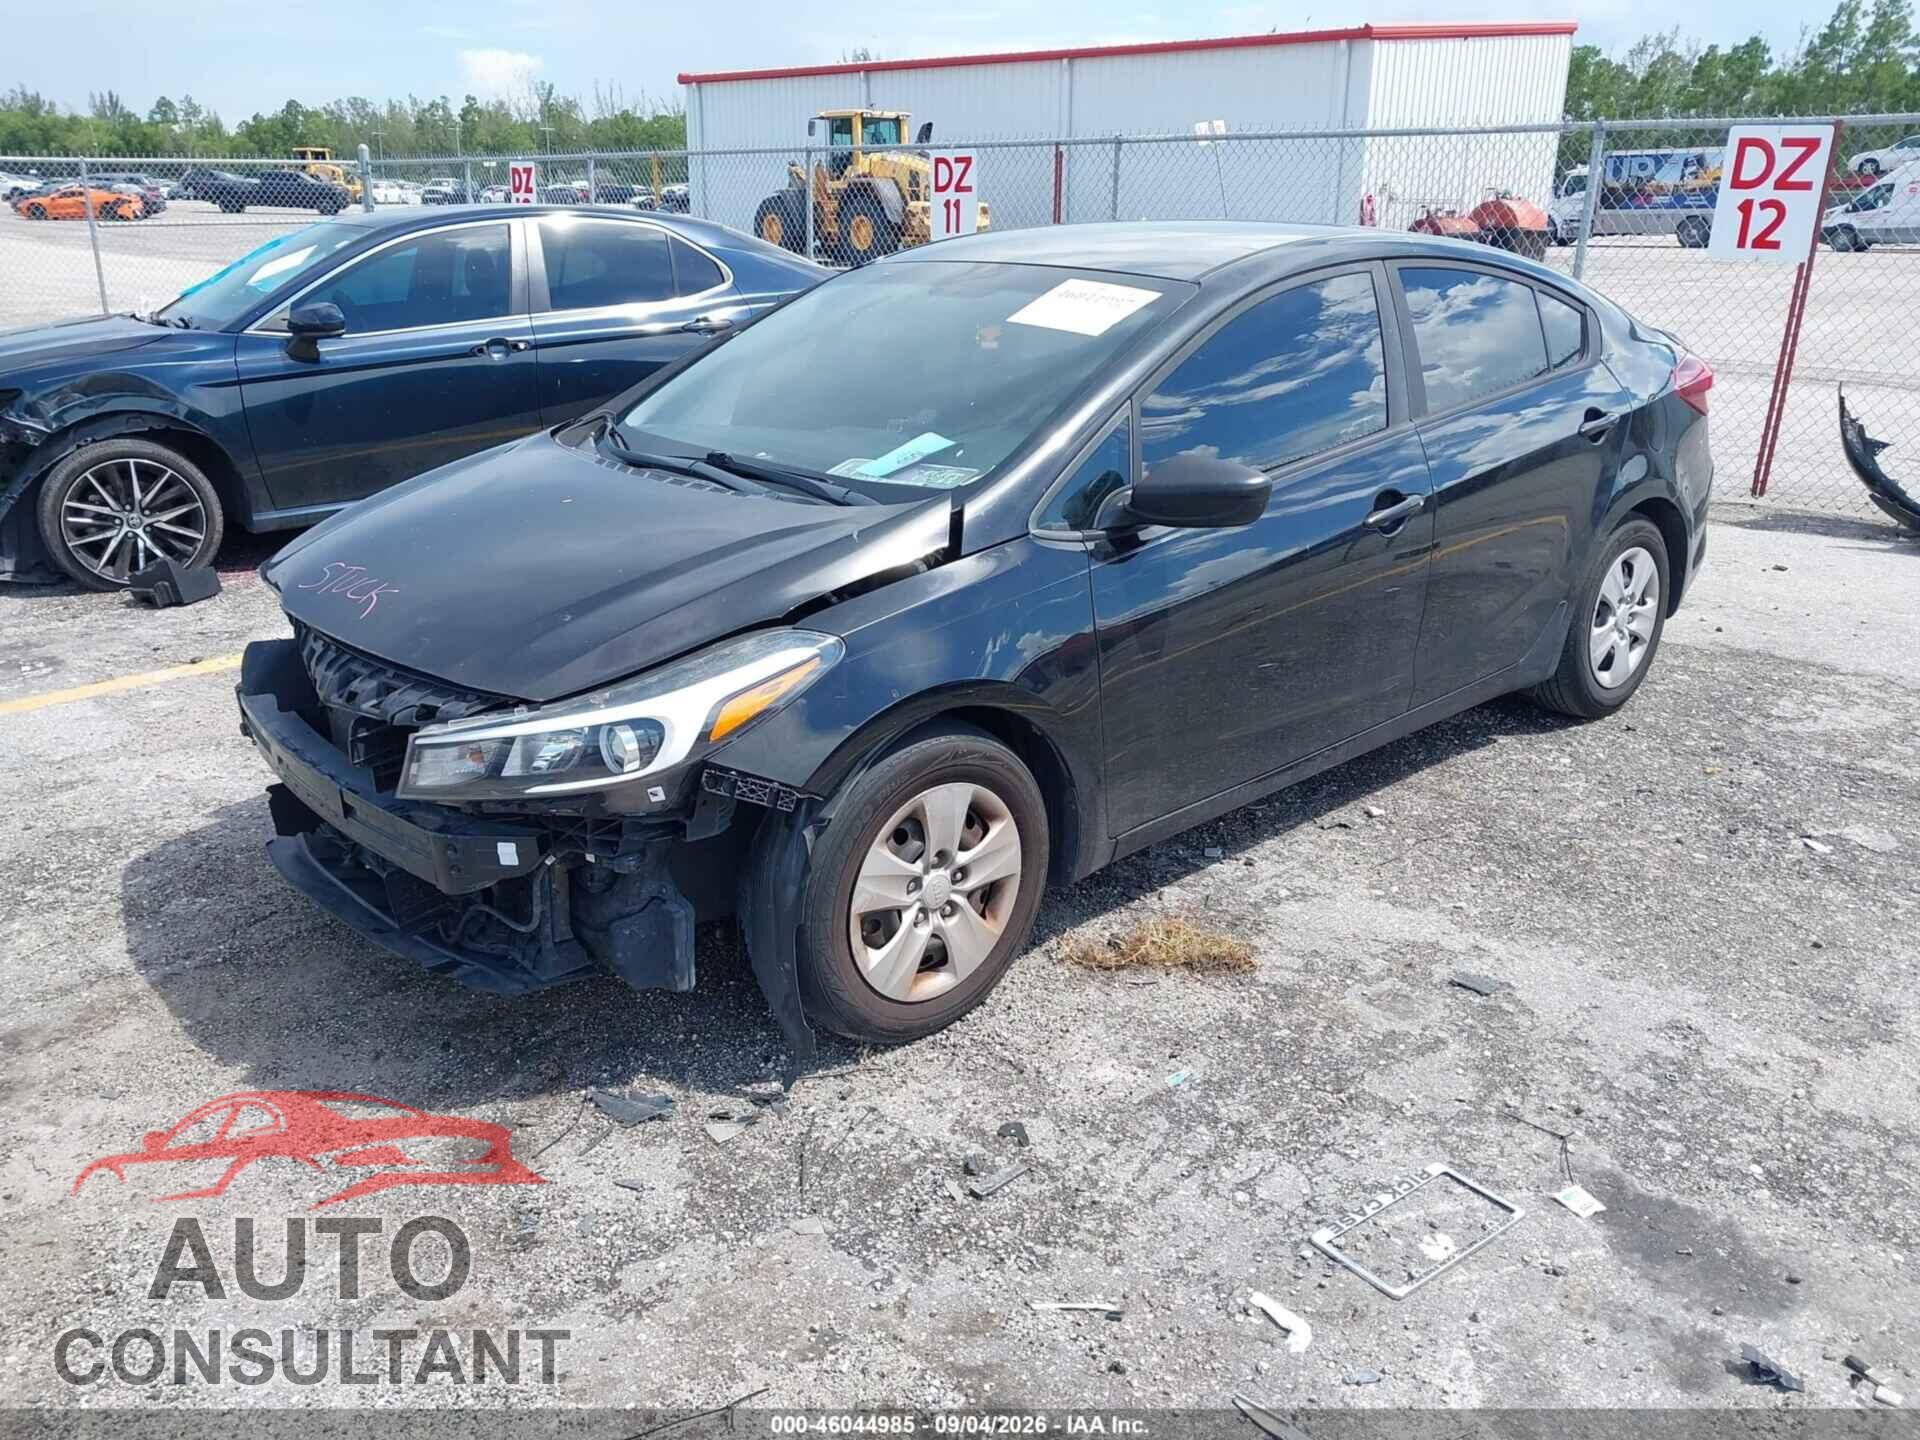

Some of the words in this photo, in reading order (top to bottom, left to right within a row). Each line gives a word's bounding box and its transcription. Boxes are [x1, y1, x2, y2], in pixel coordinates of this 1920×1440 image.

[511, 167, 533, 193] DZ
[934, 156, 973, 193] DZ
[1730, 137, 1822, 191] DZ
[943, 198, 961, 234] 11
[1736, 198, 1787, 250] 12
[1385, 1169, 1433, 1201] RICK
[1327, 1198, 1384, 1234] CASE
